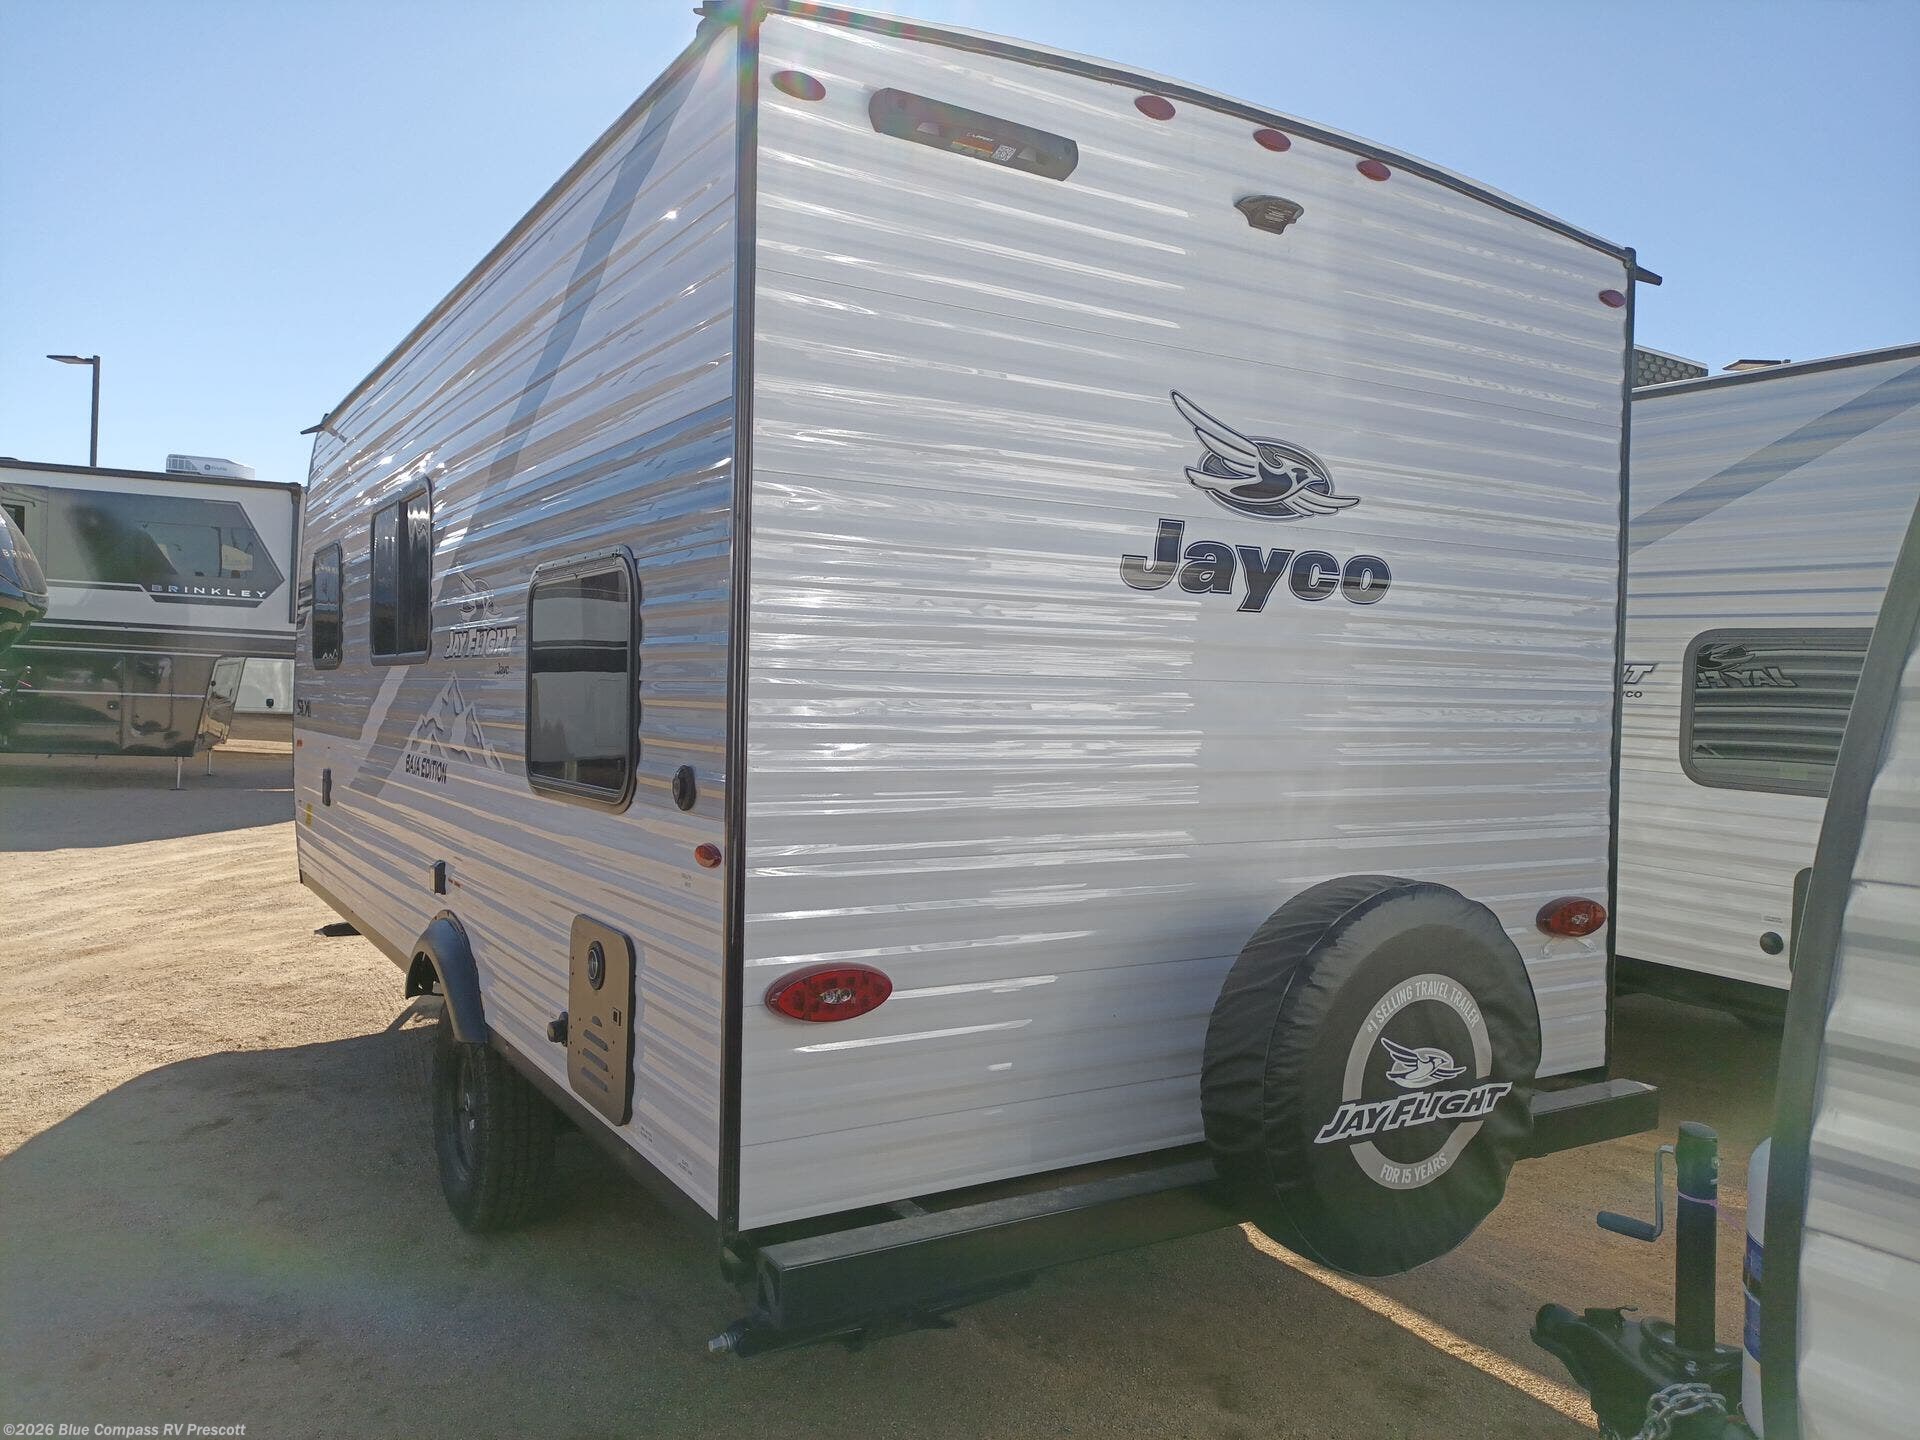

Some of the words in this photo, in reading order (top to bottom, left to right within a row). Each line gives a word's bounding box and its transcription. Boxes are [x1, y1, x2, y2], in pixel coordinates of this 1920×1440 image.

[1120, 518, 1392, 613] Jayco
[151, 584, 267, 597] BRINKLEY
[405, 753, 420, 776] BAJA
[421, 757, 448, 785] EDITION
[1375, 985, 1413, 1022] SELLING
[1415, 981, 1448, 999] TRAVEL
[1450, 987, 1479, 1028] TRAILER
[1380, 1163, 1399, 1183] FOR
[1401, 1167, 1412, 1183] 15
[1413, 1152, 1446, 1182] YEARS
